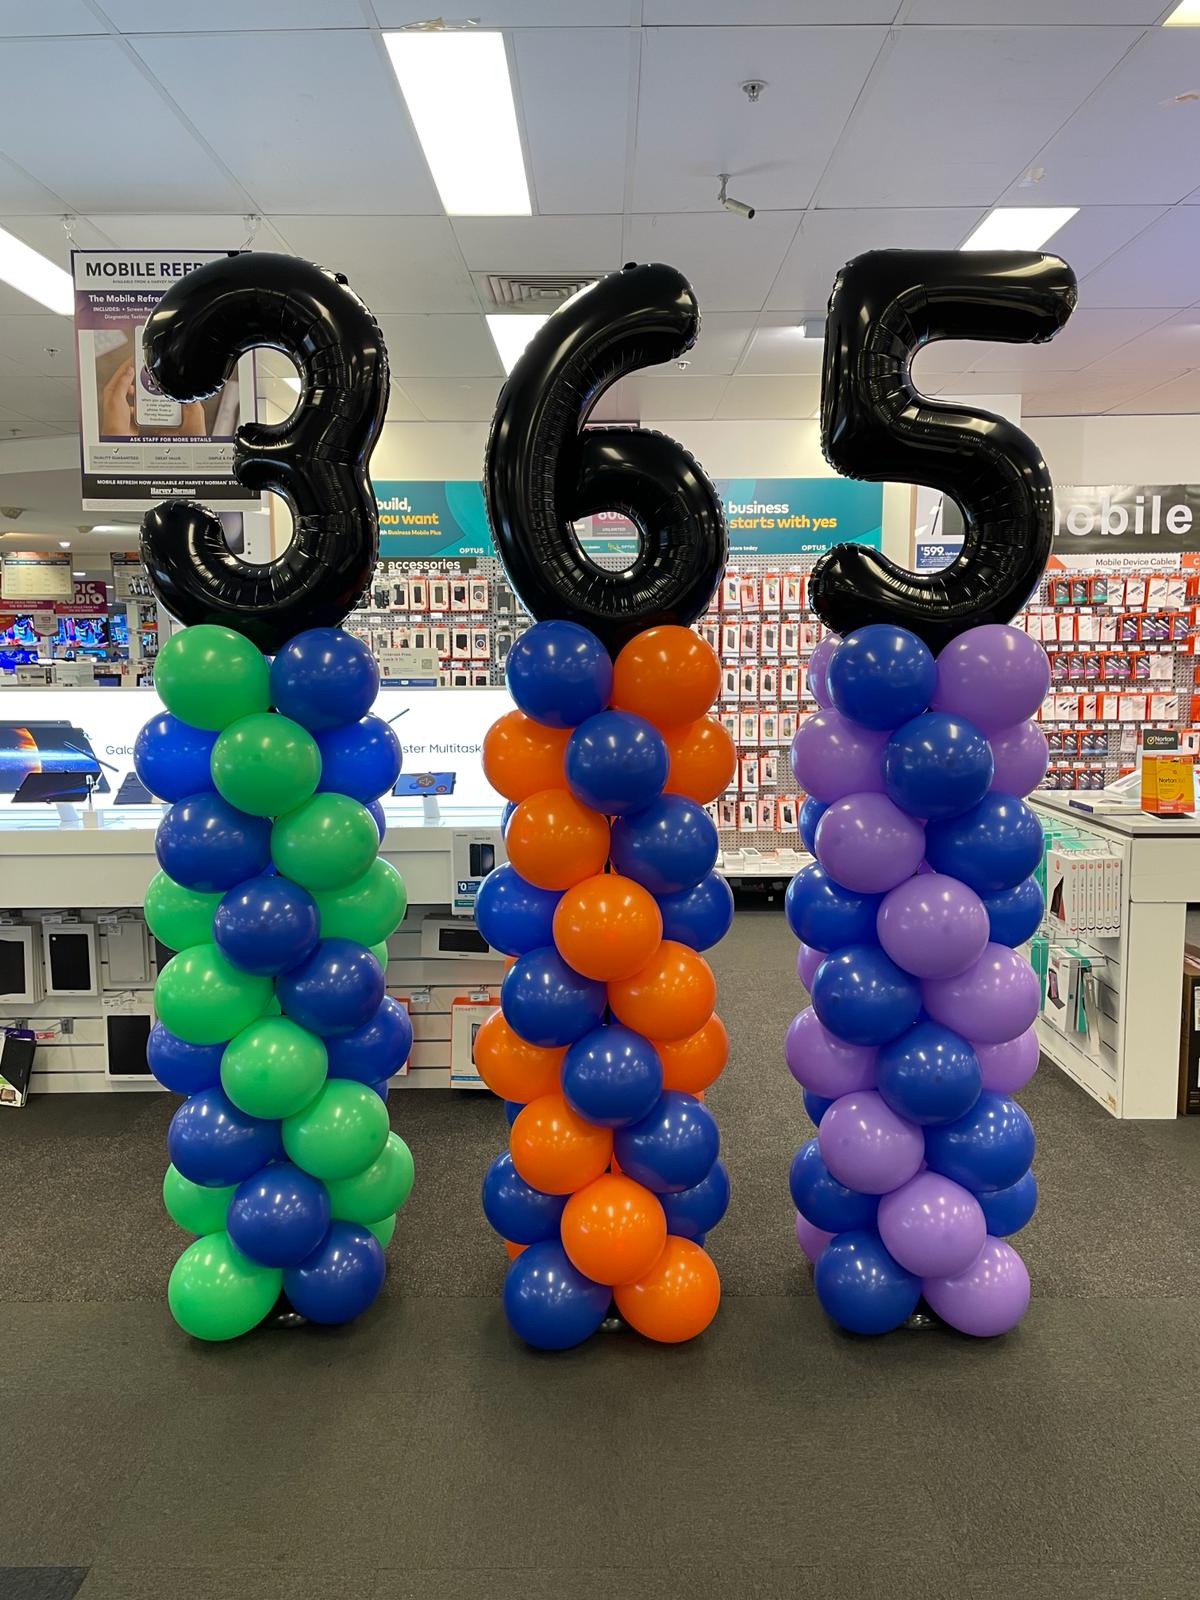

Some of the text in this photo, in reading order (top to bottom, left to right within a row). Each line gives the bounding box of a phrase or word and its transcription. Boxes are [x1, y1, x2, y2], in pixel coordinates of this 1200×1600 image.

[86, 262, 156, 276] MOBILE
[88, 294, 162, 303] The Mobile Refre
[142, 249, 1077, 652] 3 6 5
[376, 497, 412, 513] build,
[729, 502, 789, 514] business
[402, 513, 439, 525] want
[730, 515, 837, 531] starts with yes
[387, 559, 461, 570] accessories
[1095, 557, 1177, 566] Mobile Device Cables
[73, 583, 96, 594] PIC
[403, 743, 481, 754] ster Multitask
